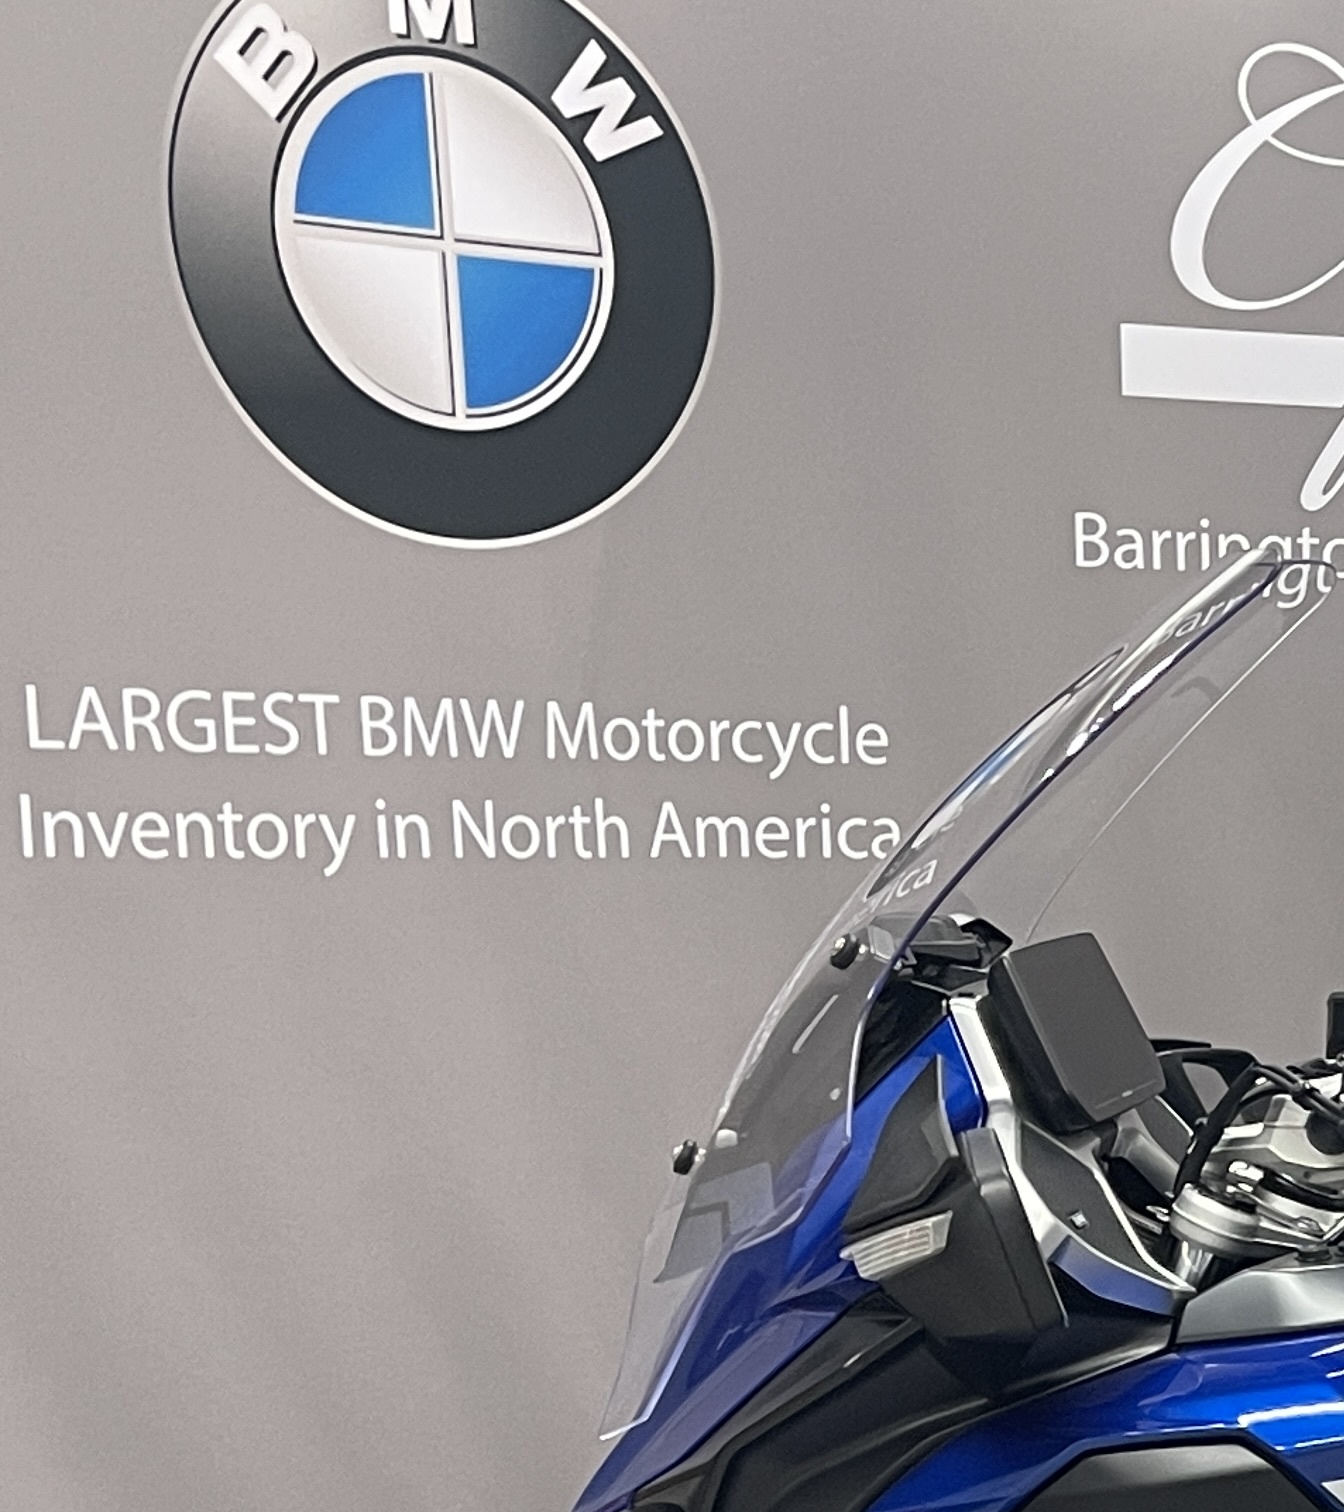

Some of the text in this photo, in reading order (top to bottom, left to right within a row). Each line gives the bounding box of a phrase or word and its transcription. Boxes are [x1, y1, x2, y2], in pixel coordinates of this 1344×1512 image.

[25, 684, 889, 780] LARGEST BMW Motorcycle
[19, 793, 901, 877] Inventory in North America
